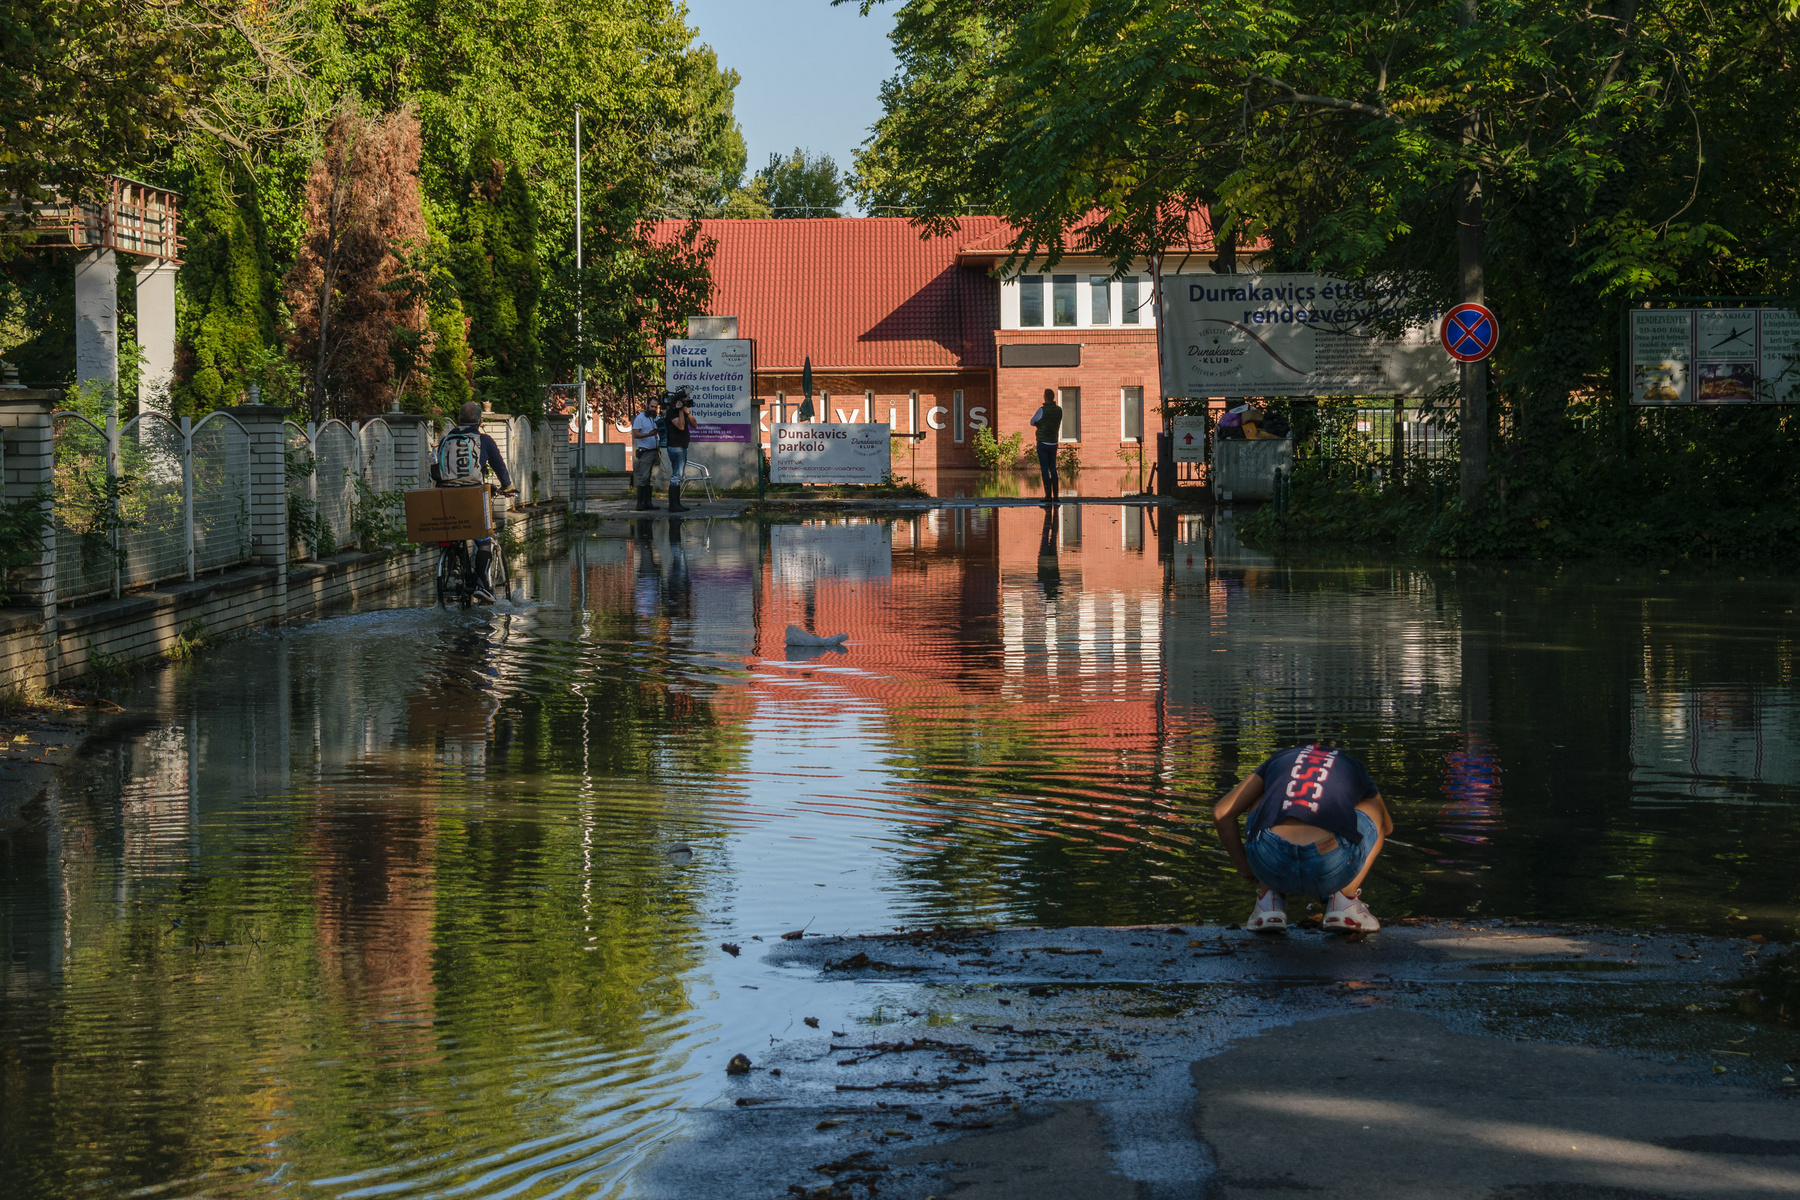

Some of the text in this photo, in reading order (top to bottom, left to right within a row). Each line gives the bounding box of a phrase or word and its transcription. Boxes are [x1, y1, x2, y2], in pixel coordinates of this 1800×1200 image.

[1189, 282, 1315, 302] Dunakavics
[1636, 314, 1688, 324] RENDEZVÉNYEK
[1700, 312, 1752, 320] CSÓNAKHÁZ
[1763, 312, 1785, 320] DUNA
[1651, 334, 1665, 342] parti
[1666, 334, 1690, 342] helyszín
[1669, 341, 1684, 349] céges
[672, 345, 707, 356] Nézze
[1188, 345, 1246, 356] Dunakavics
[672, 357, 713, 368] nálunk
[672, 372, 744, 381] óriás kivetítőn
[702, 393, 735, 401] Olimpiát
[690, 409, 741, 418] helyiségében
[779, 428, 847, 440] Dunakavics
[851, 437, 884, 446] Dunakavics
[779, 441, 825, 454] parkoló
